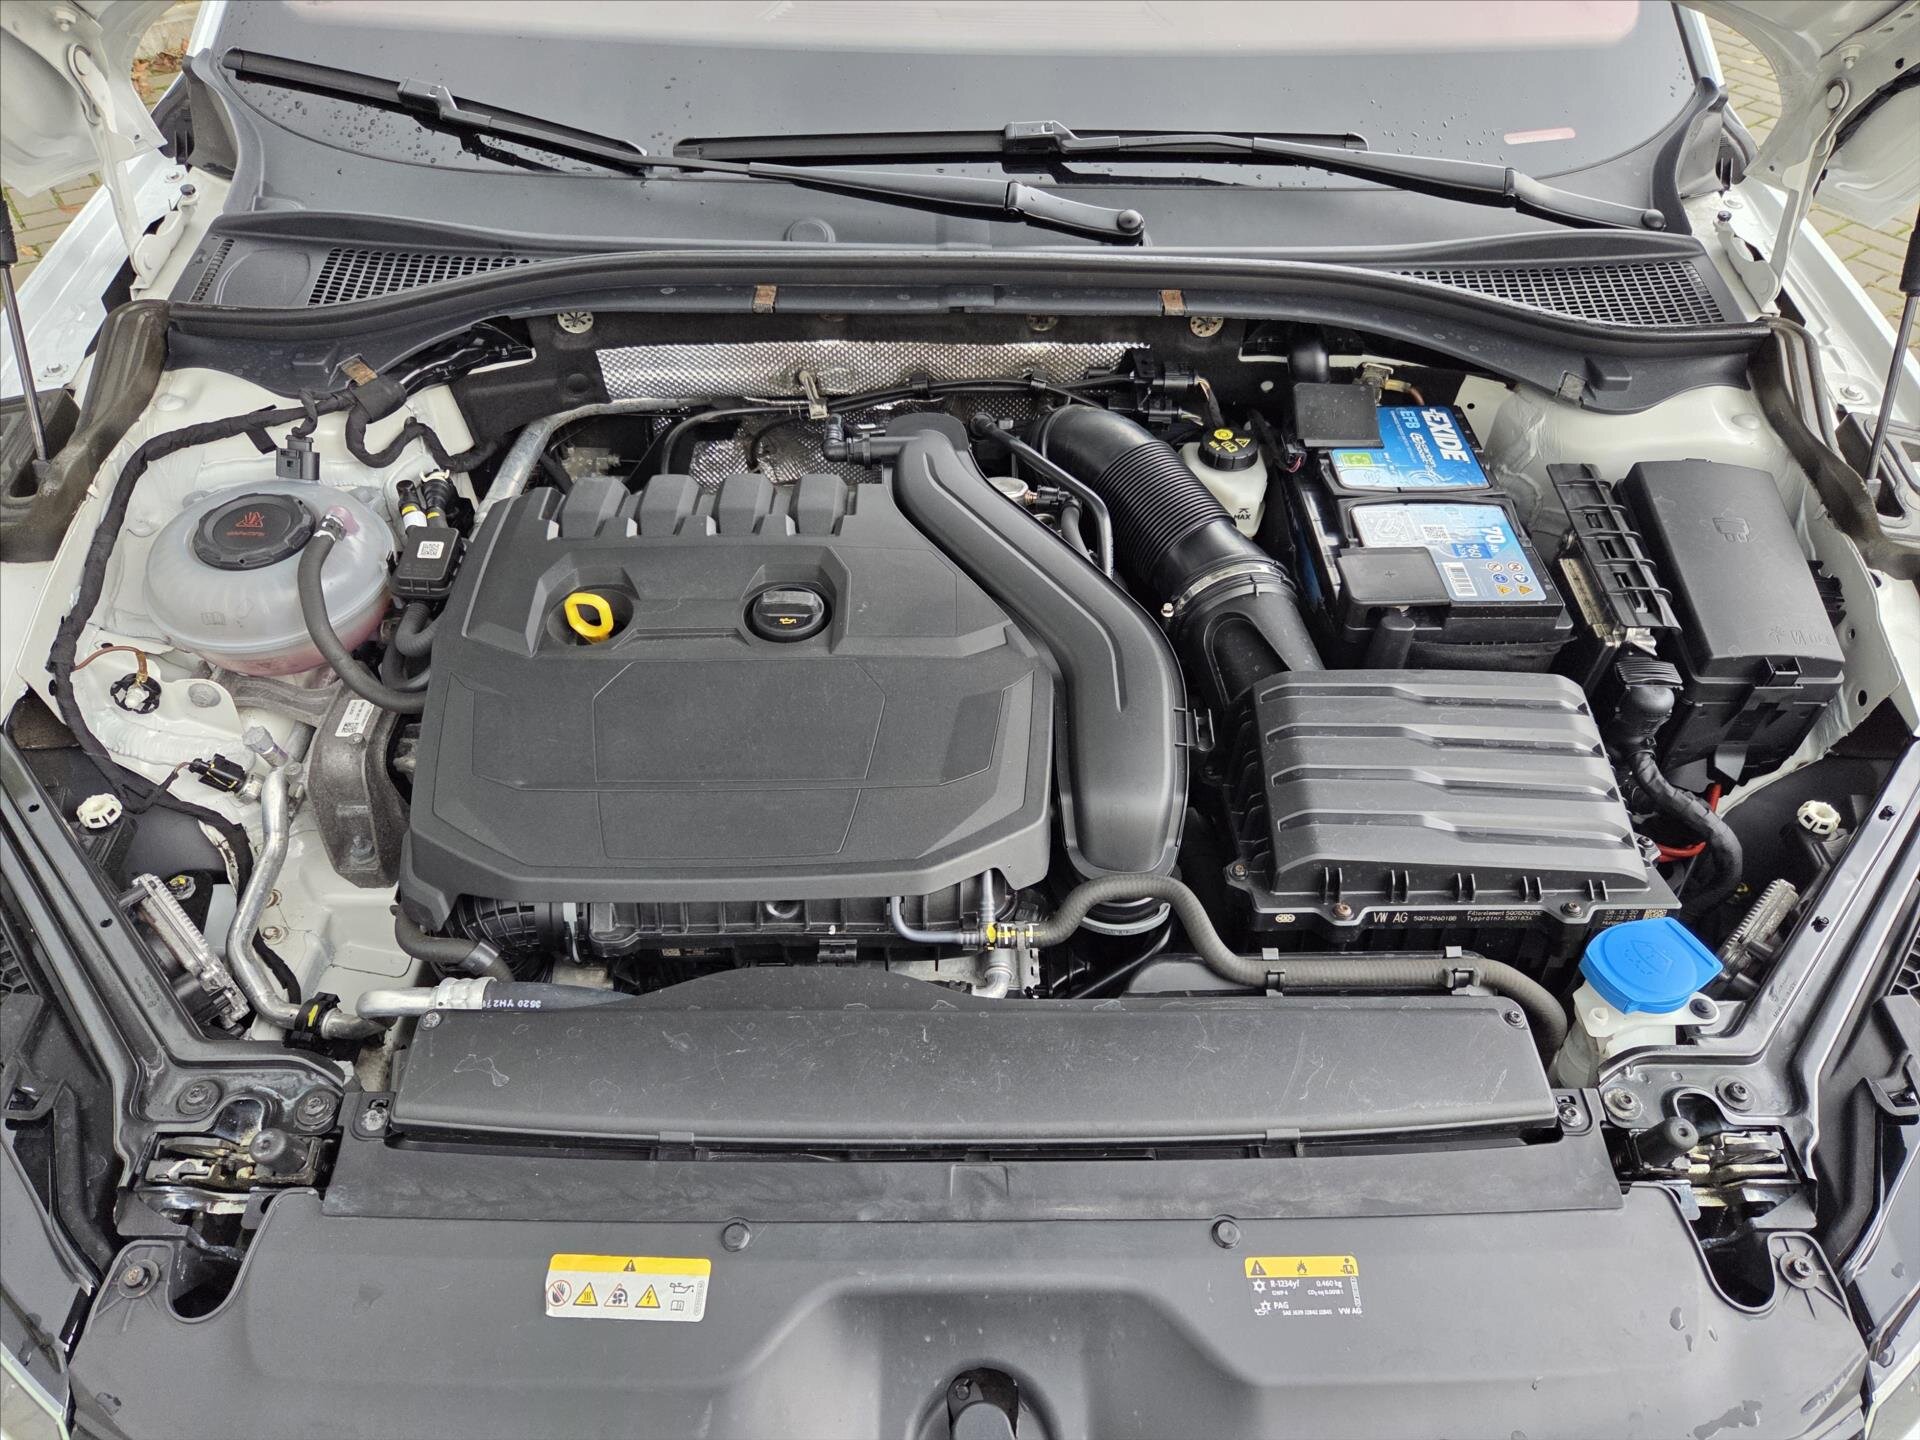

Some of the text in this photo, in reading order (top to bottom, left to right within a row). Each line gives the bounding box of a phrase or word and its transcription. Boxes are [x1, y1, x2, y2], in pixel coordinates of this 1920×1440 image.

[1400, 410, 1421, 429] EFB
[1421, 408, 1471, 464] EXIDE
[1481, 526, 1506, 544] 70
[1373, 912, 1388, 923] VW
[1392, 912, 1408, 923] AG
[1270, 1280, 1300, 1290] R-1234yf
[1273, 1301, 1290, 1310] PAG
